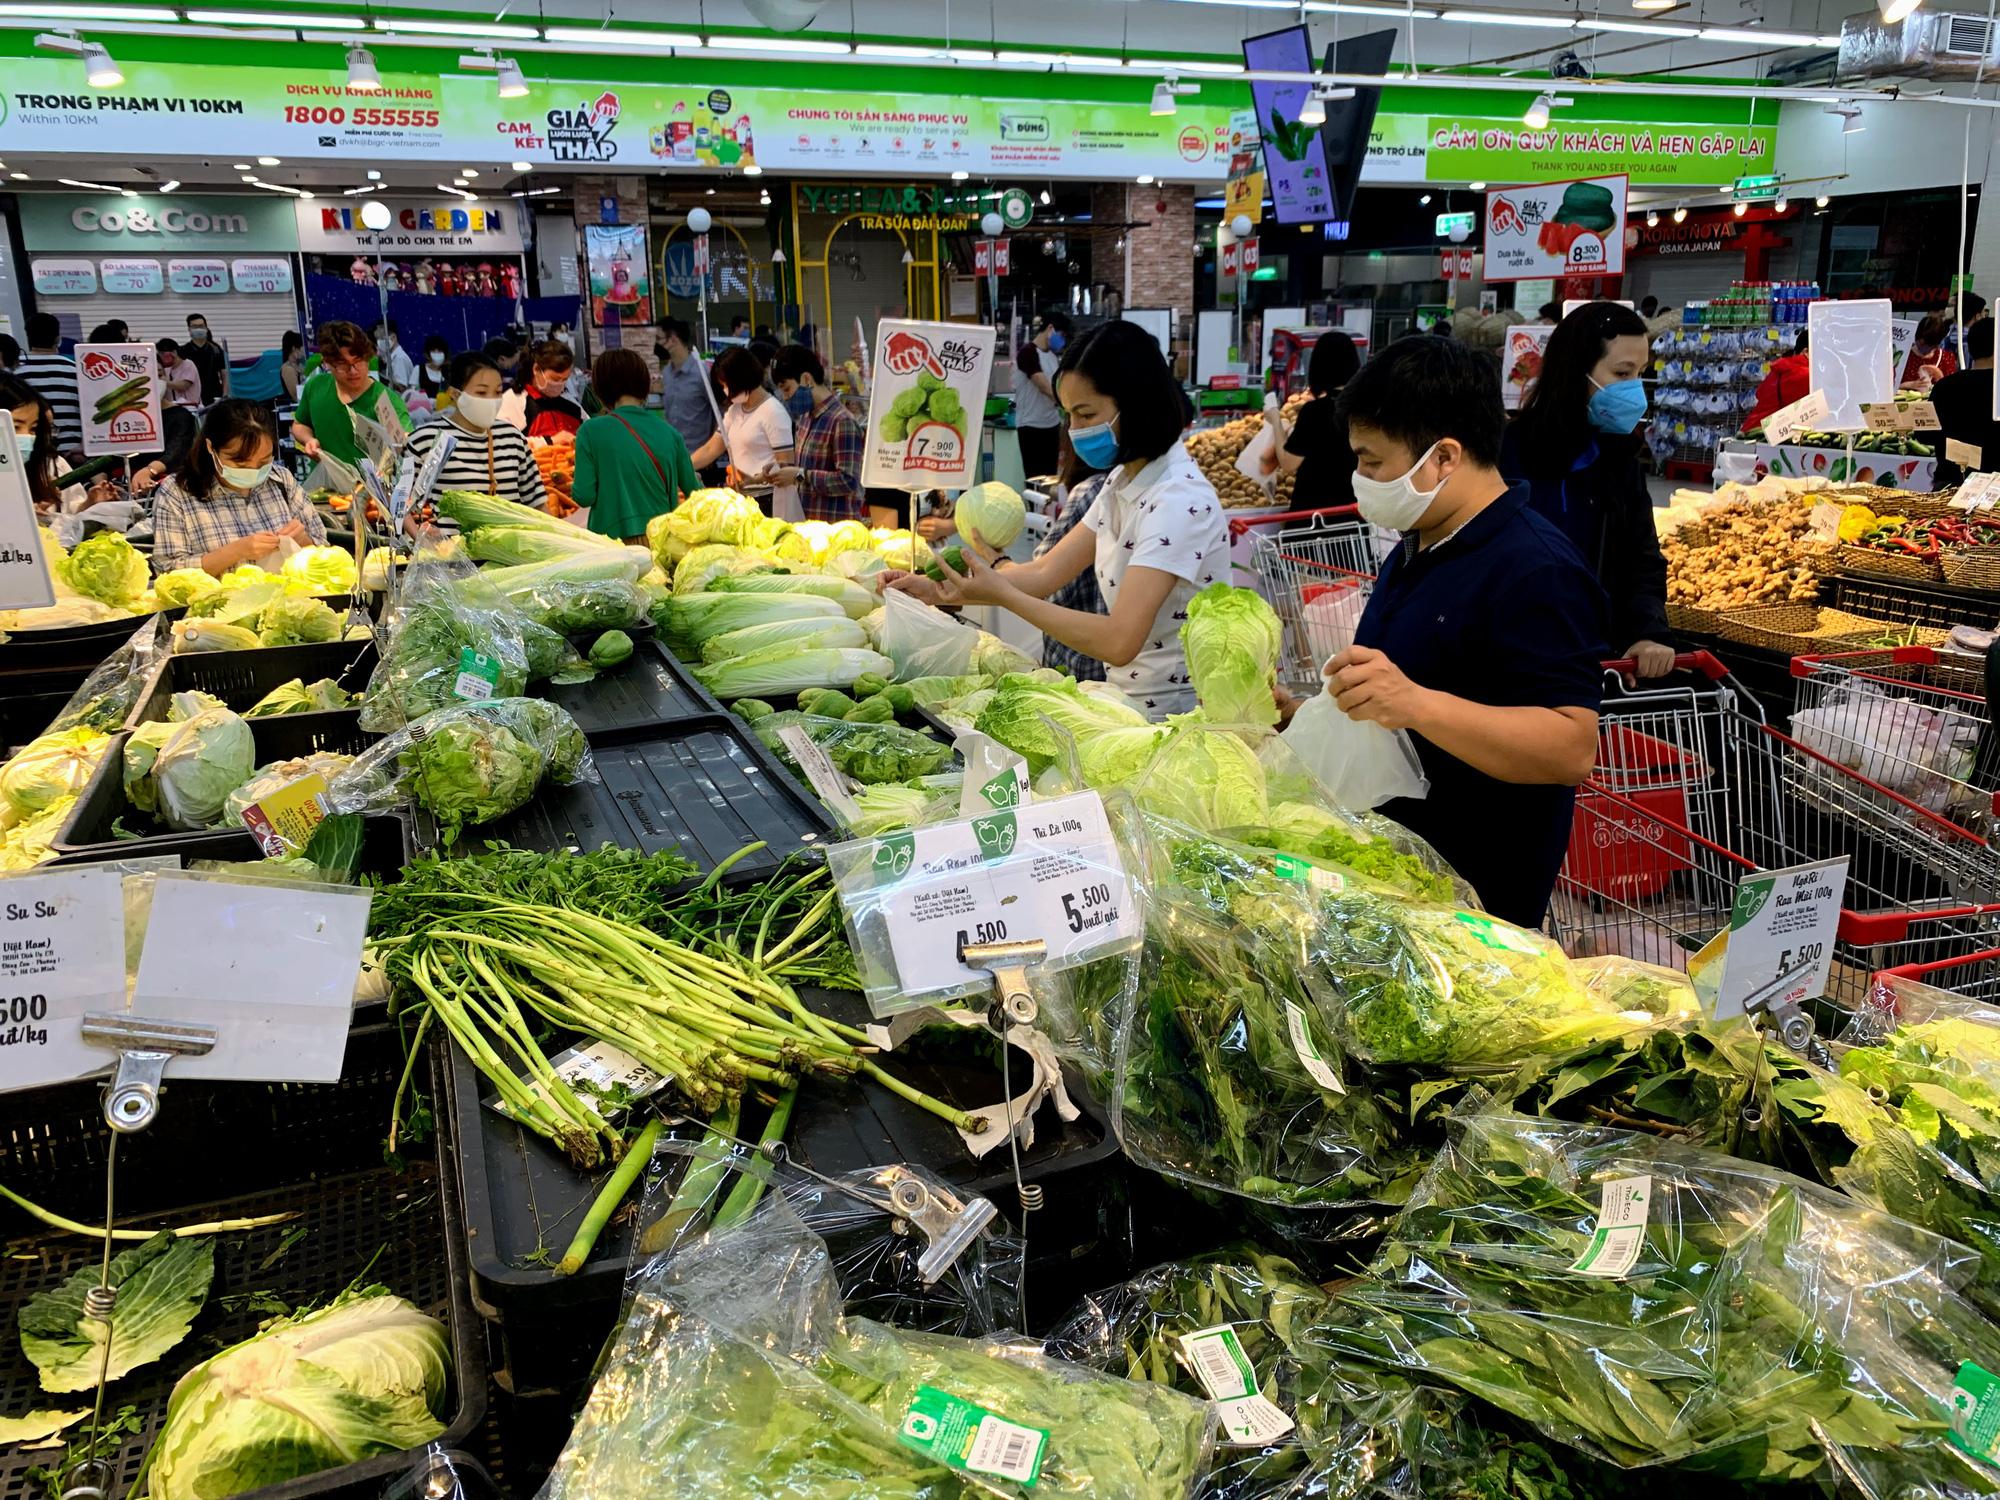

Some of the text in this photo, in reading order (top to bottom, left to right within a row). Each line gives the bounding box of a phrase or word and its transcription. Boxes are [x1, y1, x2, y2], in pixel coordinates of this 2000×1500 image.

[286, 85, 320, 97] DỊCH
[324, 86, 342, 98] VỤ
[395, 88, 433, 99] HÀNG
[15, 94, 243, 114] TRONG PHẠM VI 10KM
[18, 114, 98, 126] Within 10KM
[284, 106, 439, 127] 1800 555555
[547, 101, 591, 130] GIÁ
[788, 109, 831, 120] CHUNG
[835, 110, 853, 121] TÔI
[883, 110, 916, 122] SÀNG
[952, 113, 969, 125] VỤ
[497, 121, 532, 134] CAM
[850, 123, 969, 140] We are ready to serve you
[515, 132, 545, 149] KẾT
[1434, 123, 1766, 159] CẢM ƠN QUÝ KHÁCH VÀ HẸN GẶP LẠI
[551, 139, 617, 161] THẤP
[1407, 147, 1426, 157] LÊN
[1531, 161, 1679, 174] THANK YOU AND SEE YOU AGAIN
[72, 207, 249, 234] Co&Com
[399, 207, 502, 232] GARDEN
[859, 217, 884, 231] TRÀ
[884, 213, 910, 231] SỮA
[414, 236, 436, 246] CHƠI
[458, 238, 473, 246] EM
[1660, 240, 1721, 255] OSAKA JAPAN
[1244, 247, 1257, 266] 03
[1442, 257, 1453, 273] 01
[1460, 256, 1473, 273] 02
[943, 340, 968, 354] GIÁ
[116, 421, 130, 433] 13
[1032, 819, 1083, 840] Thì Là 100g
[1775, 886, 1833, 908] Rau Mùi 100g
[7, 900, 58, 921] Su Su
[25, 937, 51, 951] Nam)
